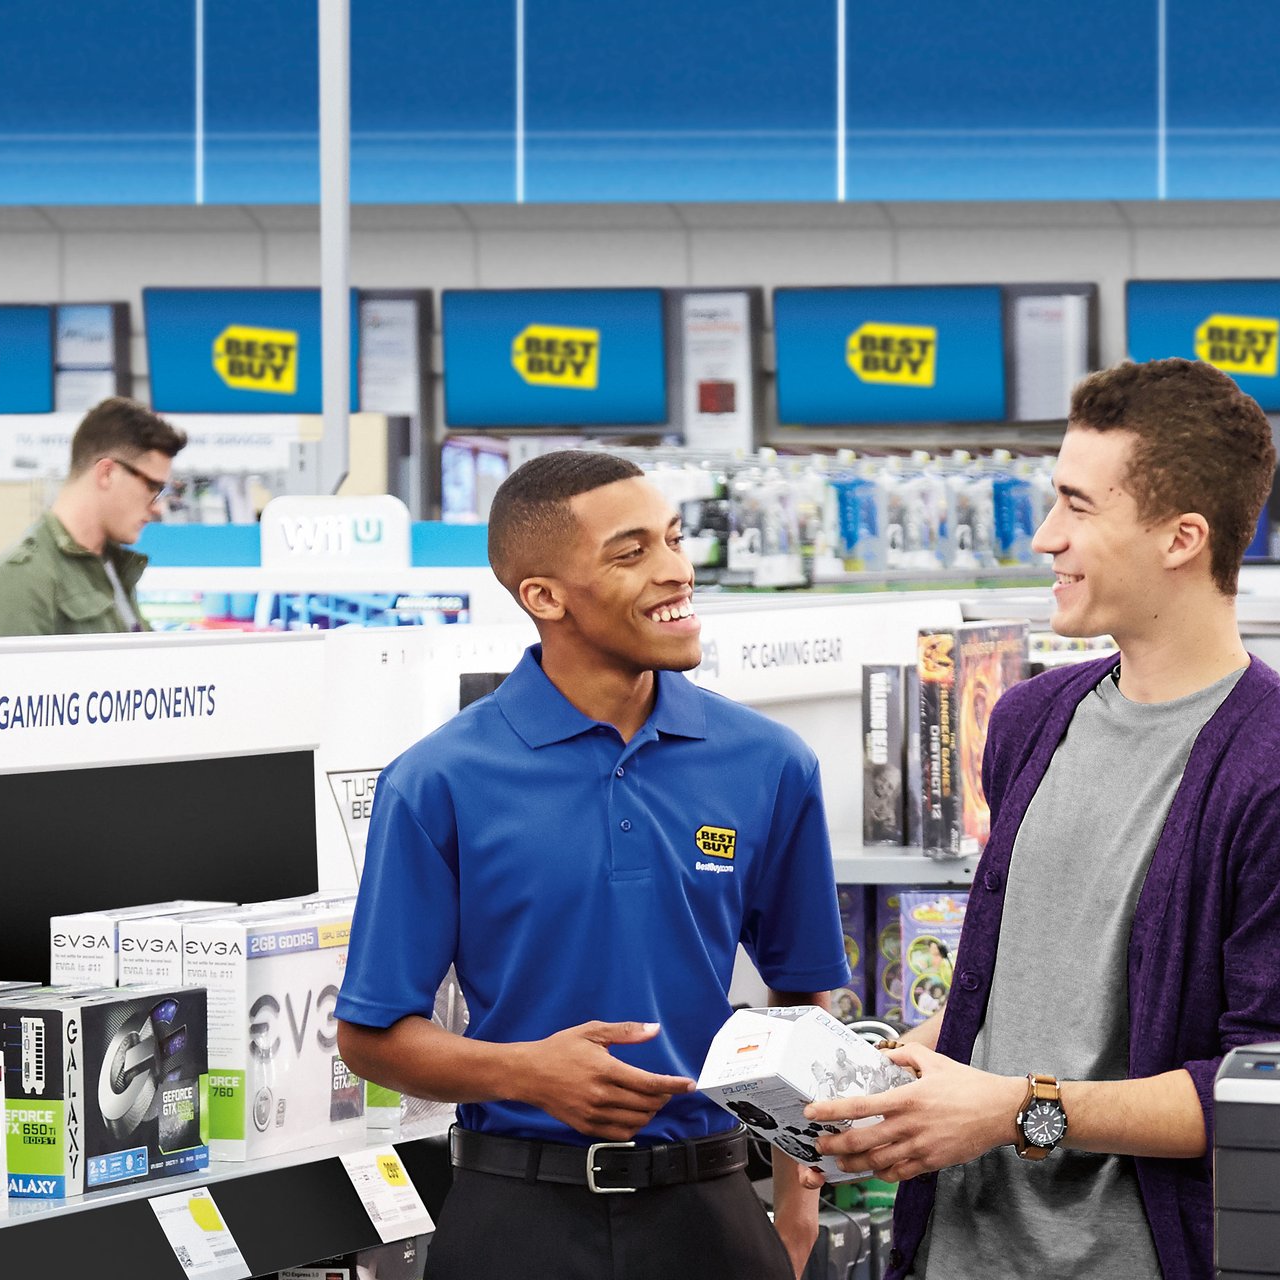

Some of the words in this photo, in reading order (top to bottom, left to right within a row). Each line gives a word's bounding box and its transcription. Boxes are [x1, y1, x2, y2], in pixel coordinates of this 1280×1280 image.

[858, 334, 932, 358] BEST
[1206, 325, 1276, 349] BEST
[224, 337, 294, 363] BEST
[524, 336, 595, 360] BEST
[1209, 345, 1267, 366] BUY
[227, 360, 286, 382] BUY
[526, 357, 587, 378] BUY
[861, 355, 923, 375] BUY
[742, 645, 762, 670] PC
[762, 641, 810, 667] GAMING
[814, 639, 842, 663] GEAR
[86, 684, 217, 724] COMPONENTS
[930, 725, 942, 796] DISTRICT
[701, 831, 735, 844] BEST
[703, 842, 730, 855] BUY
[53, 934, 110, 949] EVGA
[121, 938, 178, 952] EVGA
[185, 941, 242, 955] EVGA
[251, 935, 276, 952] 2GB
[279, 932, 313, 949] GDDR5
[162, 1087, 193, 1103] GEFORCE
[213, 1086, 233, 1098] 760
[163, 1102, 177, 1116] GTX
[23, 1124, 47, 1136] 650
[49, 1127, 56, 1136] Ti
